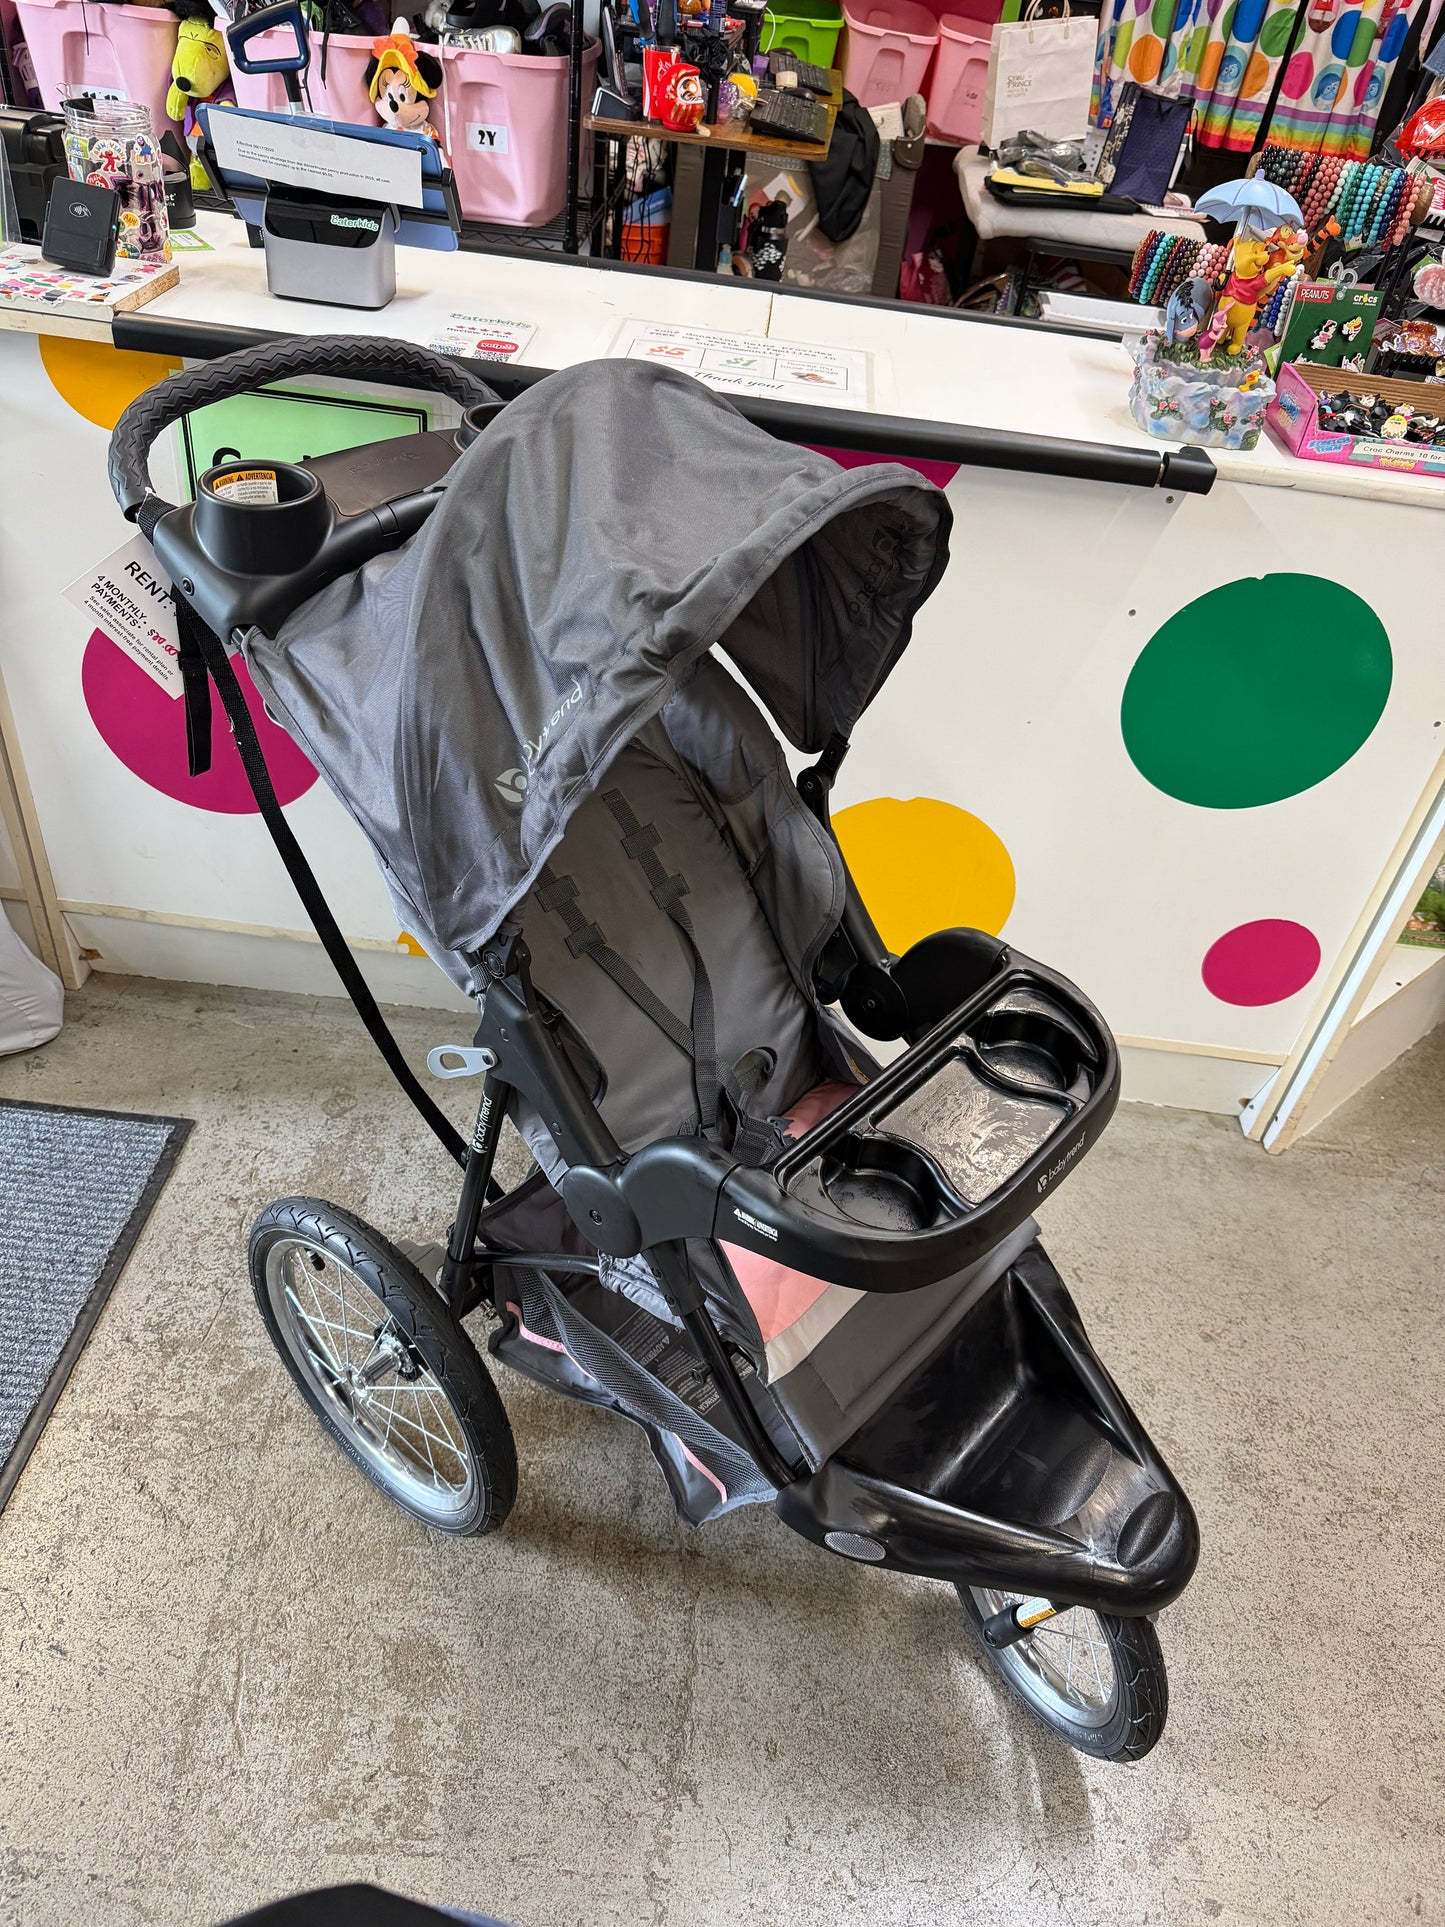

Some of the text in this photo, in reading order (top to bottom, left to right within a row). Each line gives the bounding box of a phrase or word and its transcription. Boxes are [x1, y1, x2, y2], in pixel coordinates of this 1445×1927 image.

[478, 130, 497, 146] 2Y
[1300, 288, 1330, 300] PEANUTS
[649, 345, 691, 356] $5
[725, 357, 758, 367] $1
[693, 371, 742, 385] Thank
[1363, 445, 1383, 453] Croc
[1385, 448, 1415, 457] Charms
[124, 561, 173, 609] RENT:
[87, 604, 104, 621] month
[103, 617, 134, 647] interest-free
[131, 645, 153, 666] payment
[89, 596, 174, 676] See sales associate for rental plan or
[475, 1090, 492, 1143] babytrend
[1048, 1131, 1086, 1181] babytrend
